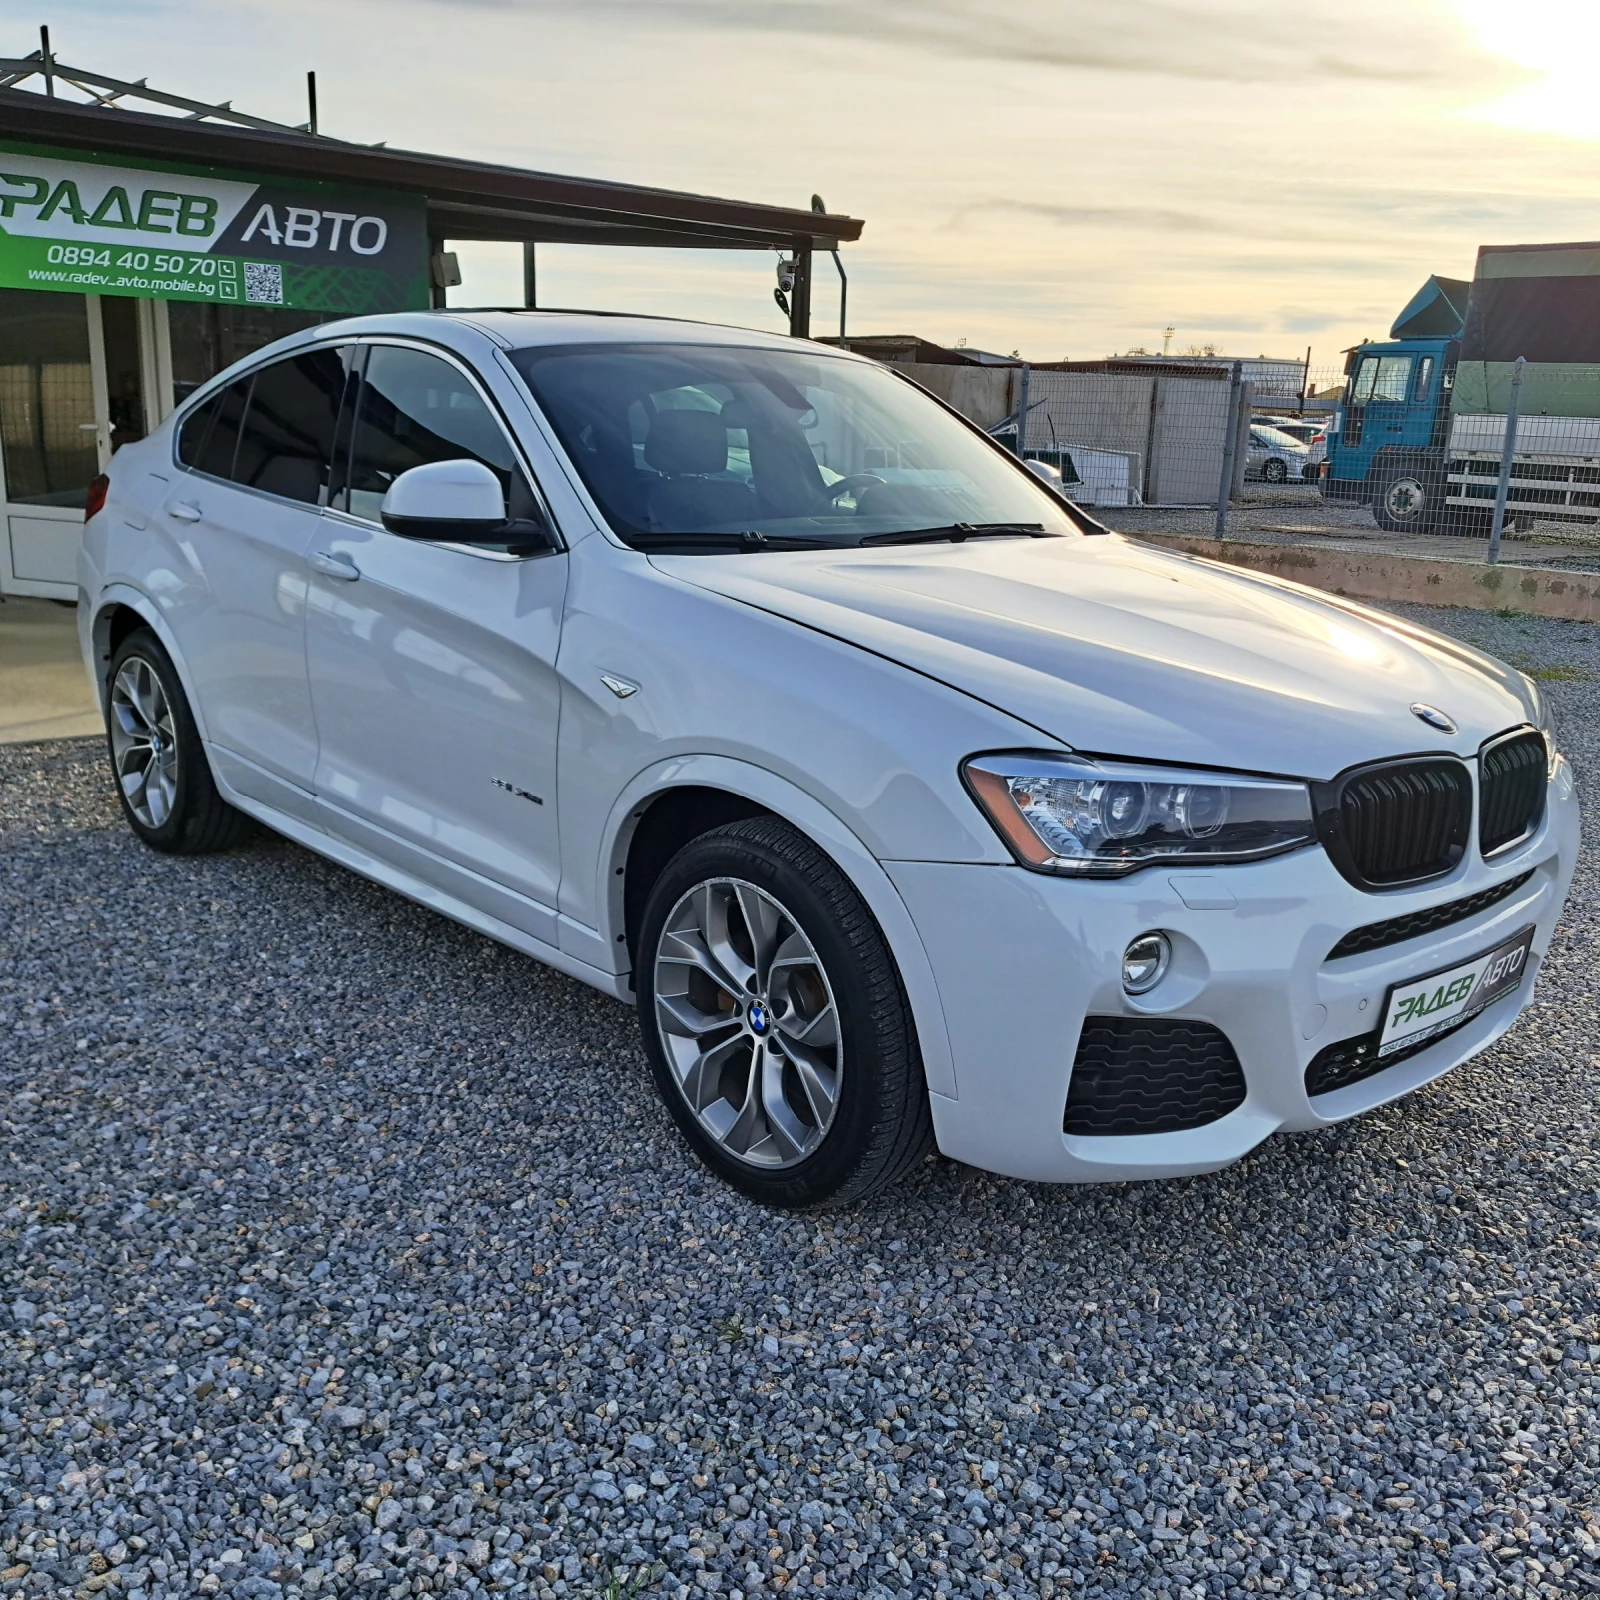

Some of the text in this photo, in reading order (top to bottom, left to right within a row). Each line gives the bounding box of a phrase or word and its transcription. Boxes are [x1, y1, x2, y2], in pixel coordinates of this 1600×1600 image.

[0, 173, 388, 255] РАДЕВ АВТО
[28, 269, 215, 296] www.radev_avto.mobile.bg
[47, 245, 216, 276] 0894 40 50 70
[1392, 973, 1476, 1028] РАДЕВ
[1474, 945, 1525, 994] АВТО
